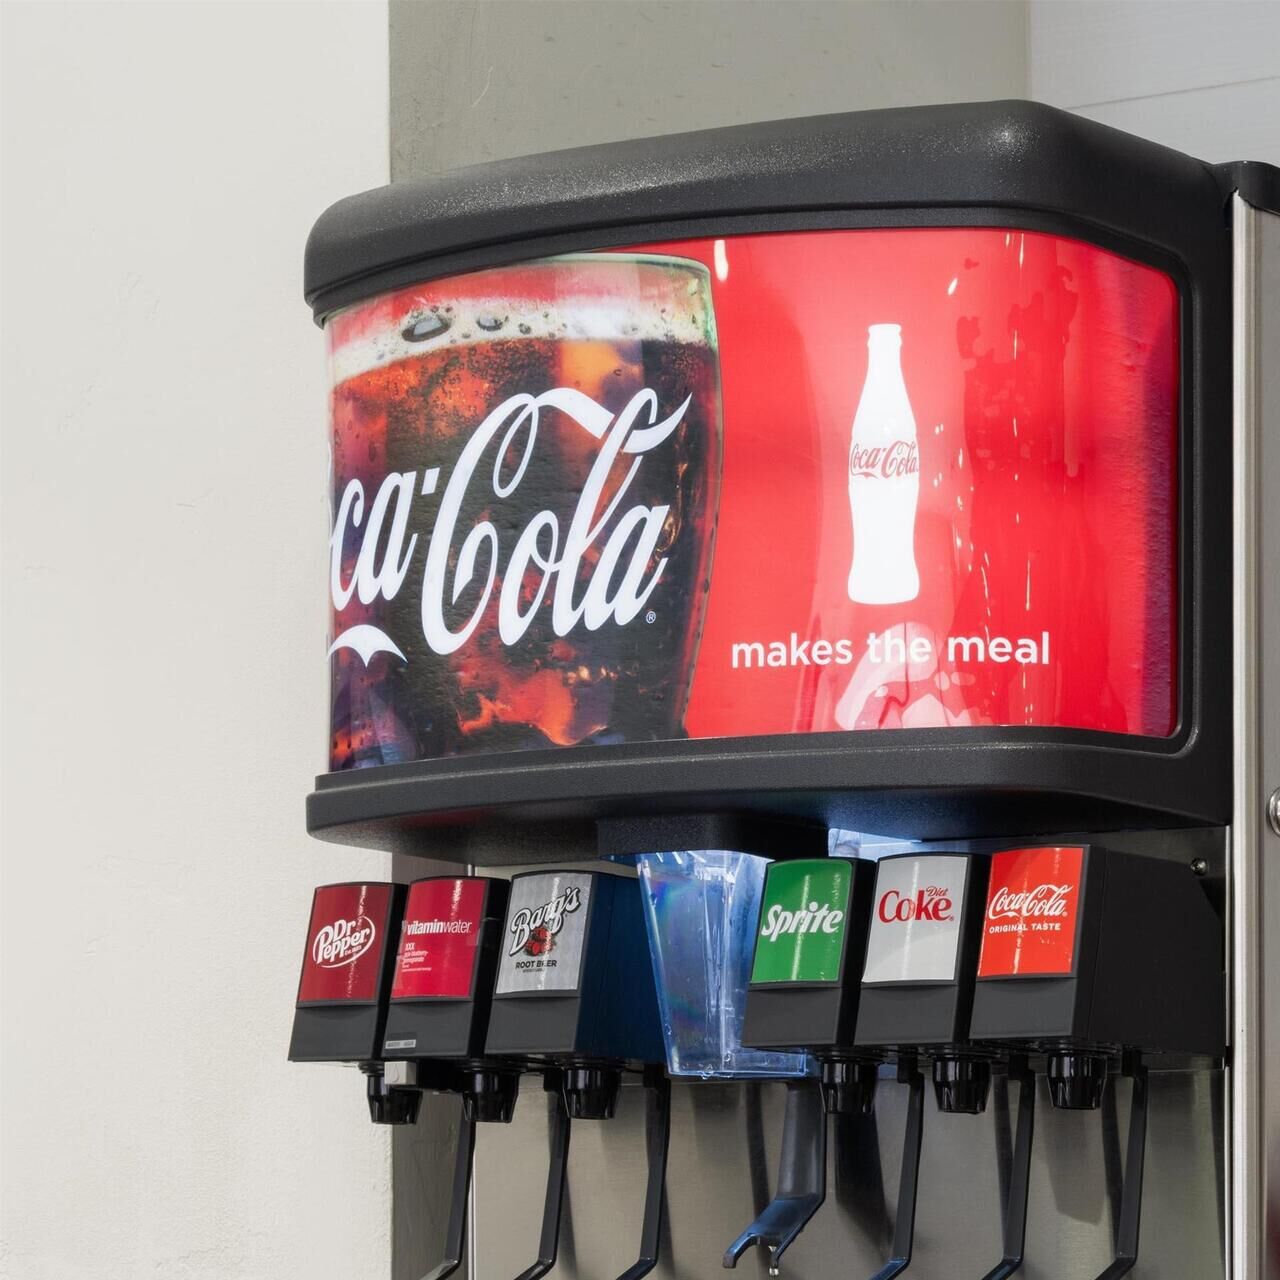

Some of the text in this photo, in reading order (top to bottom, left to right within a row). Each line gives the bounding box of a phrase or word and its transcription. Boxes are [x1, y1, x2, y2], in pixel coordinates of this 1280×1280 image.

[851, 440, 919, 479] Coca-Cola
[731, 631, 1050, 669] makes the meal
[879, 888, 952, 923] Coke
[926, 885, 948, 901] Diet
[987, 884, 1073, 919] Coca-Cola
[332, 919, 356, 942] Dr
[407, 919, 472, 936] vitaminwater
[509, 887, 581, 956] Barq's
[761, 901, 843, 942] Sprite
[989, 922, 1061, 935] ORIGINAL TASTE
[317, 926, 370, 964] Pepper
[516, 960, 535, 969] ROOT
